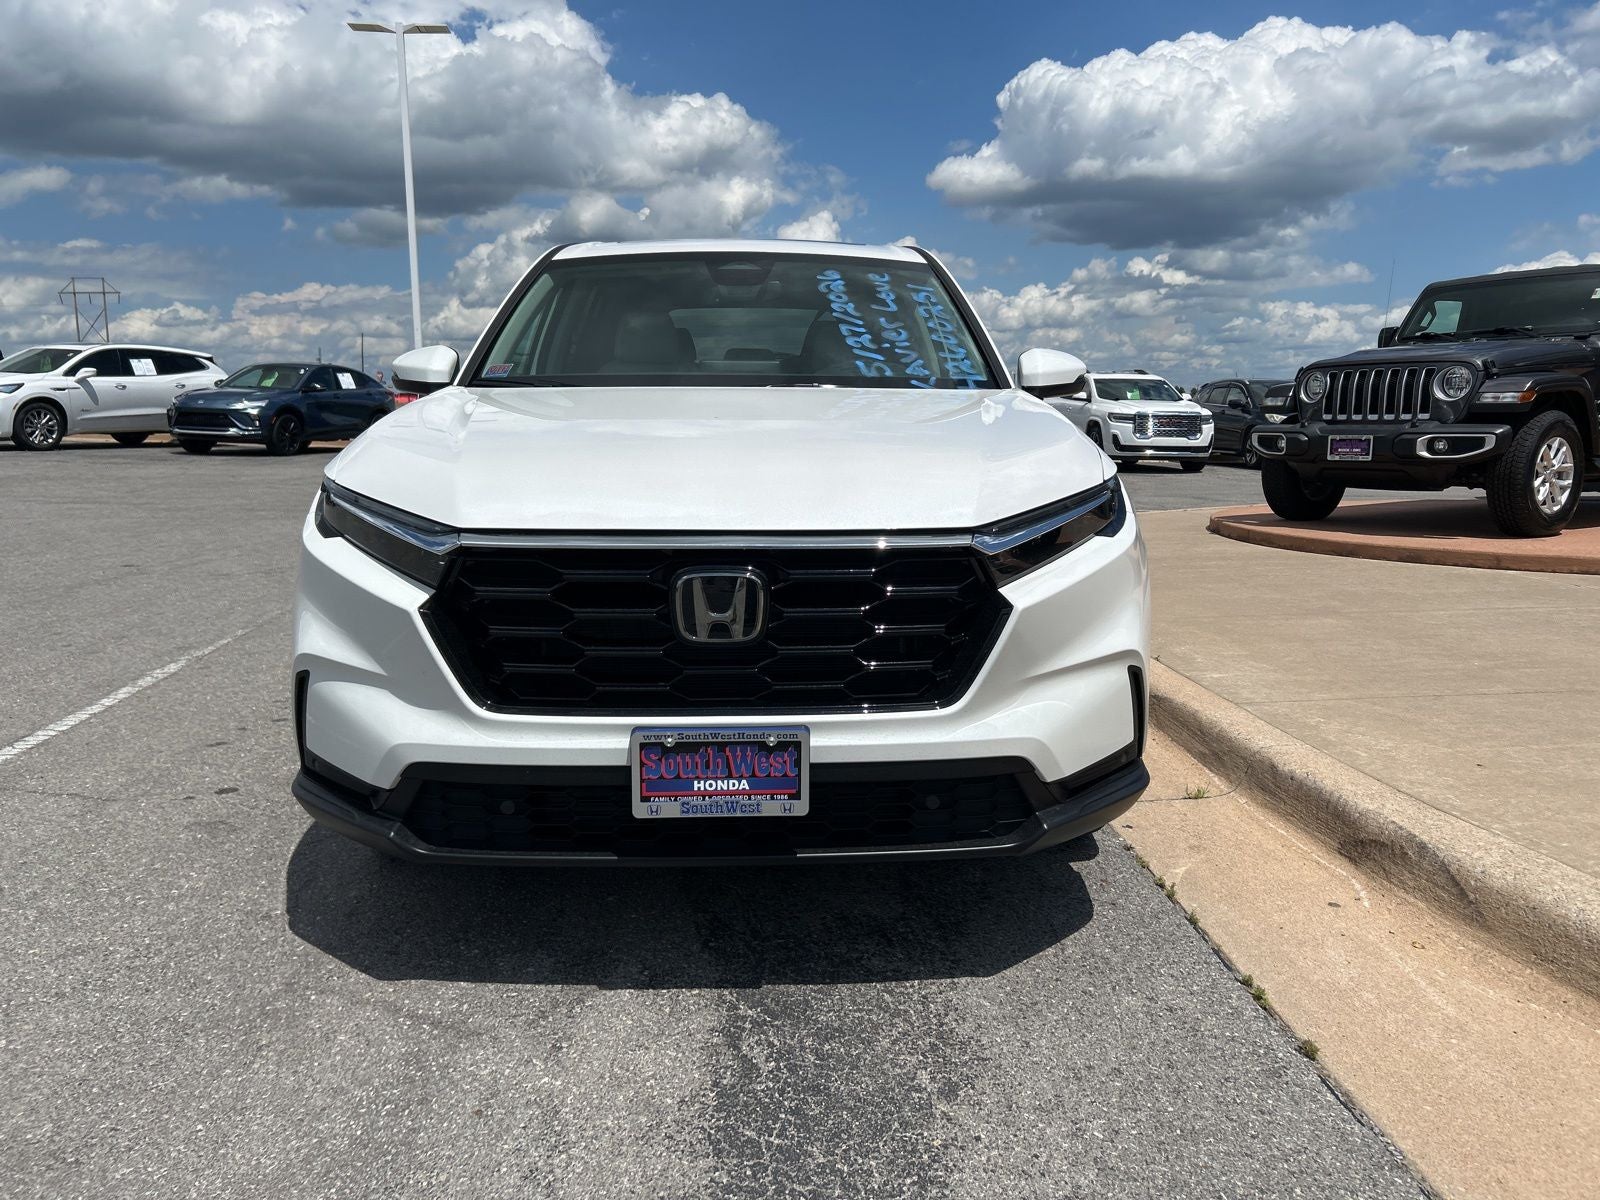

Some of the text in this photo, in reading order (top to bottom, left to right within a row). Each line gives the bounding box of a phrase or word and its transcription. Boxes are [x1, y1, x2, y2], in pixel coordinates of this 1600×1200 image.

[642, 732, 799, 741] www.SouthWestHondacom
[640, 744, 799, 780] SouthWest
[693, 779, 750, 791] HONDA
[680, 801, 762, 816] SouthWest
